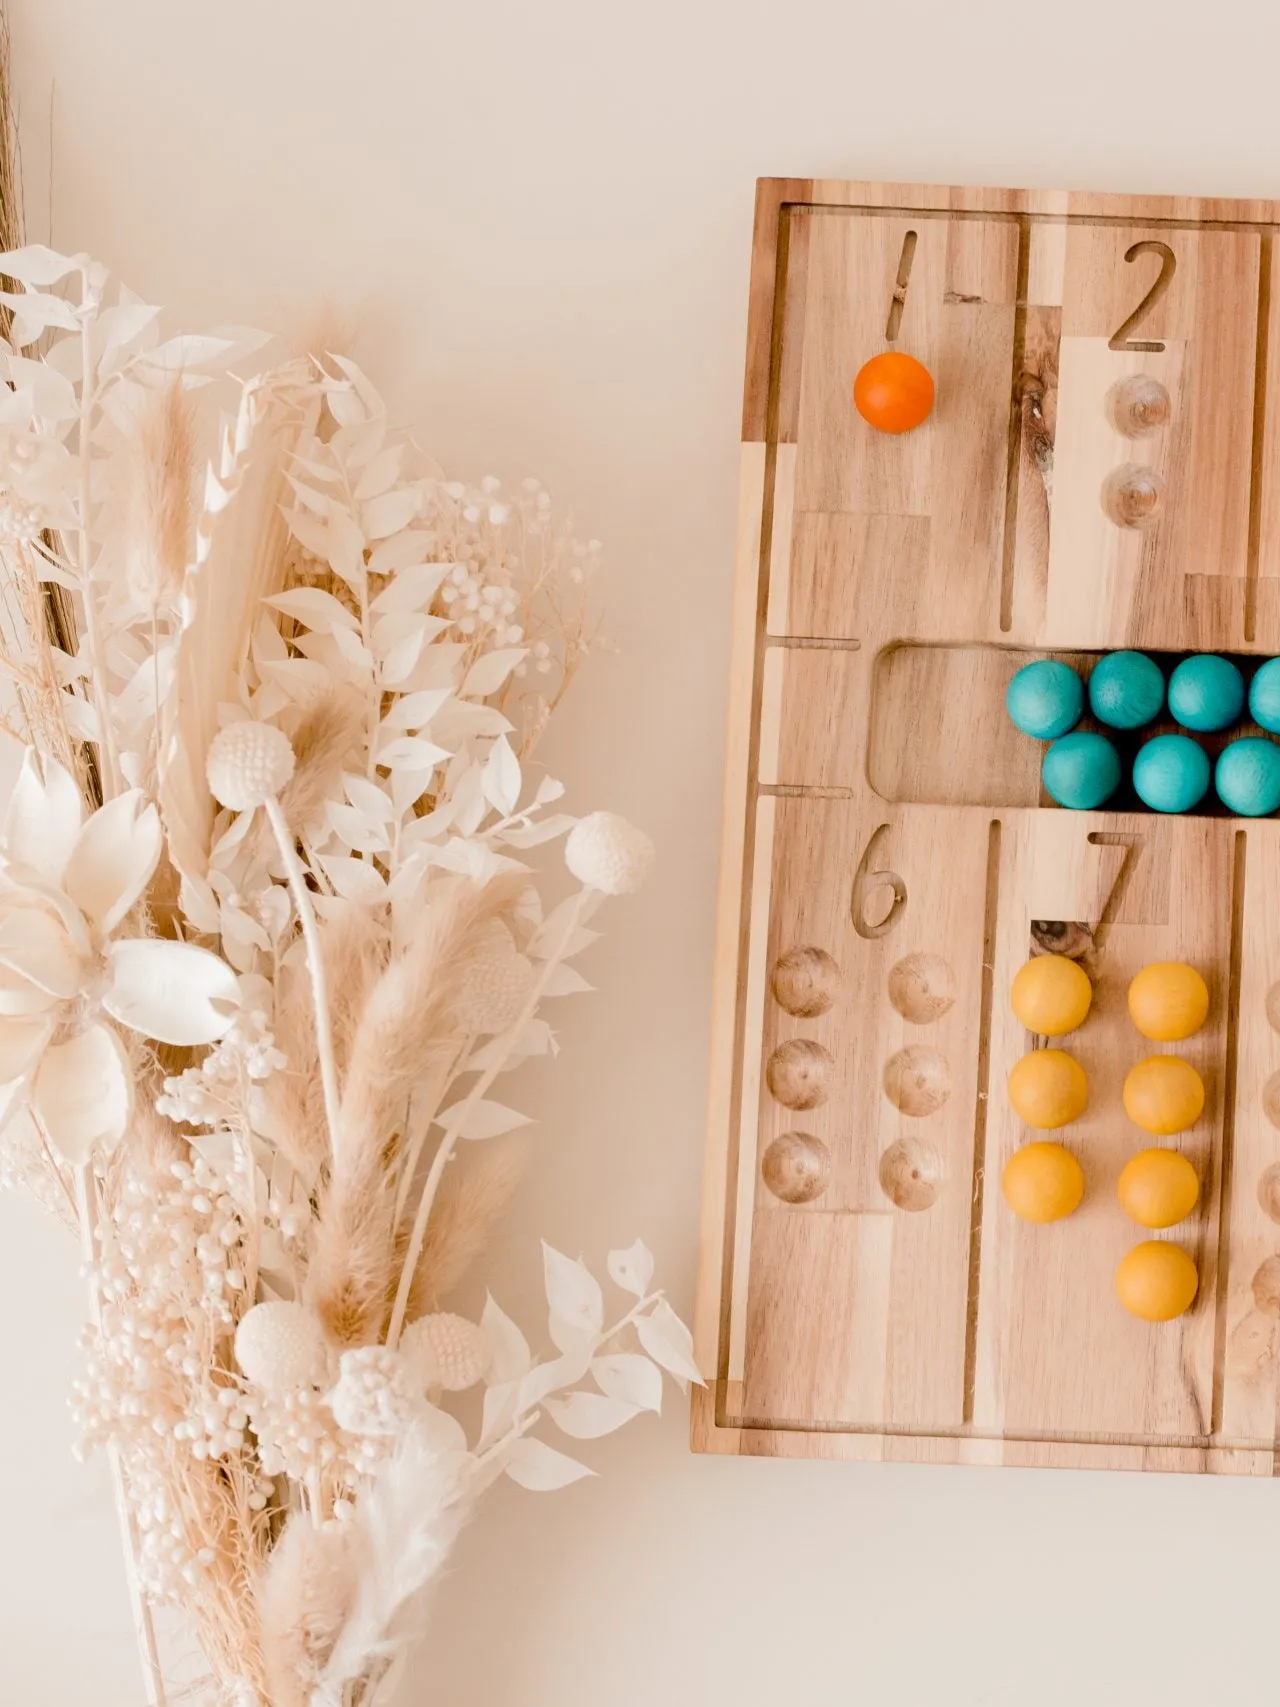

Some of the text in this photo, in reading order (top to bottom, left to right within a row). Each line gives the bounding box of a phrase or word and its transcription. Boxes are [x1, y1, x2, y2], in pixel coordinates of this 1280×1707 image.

[885, 230, 918, 342] 1
[1108, 240, 1177, 352] 2
[850, 823, 908, 939] 6
[1087, 831, 1146, 950] 7
